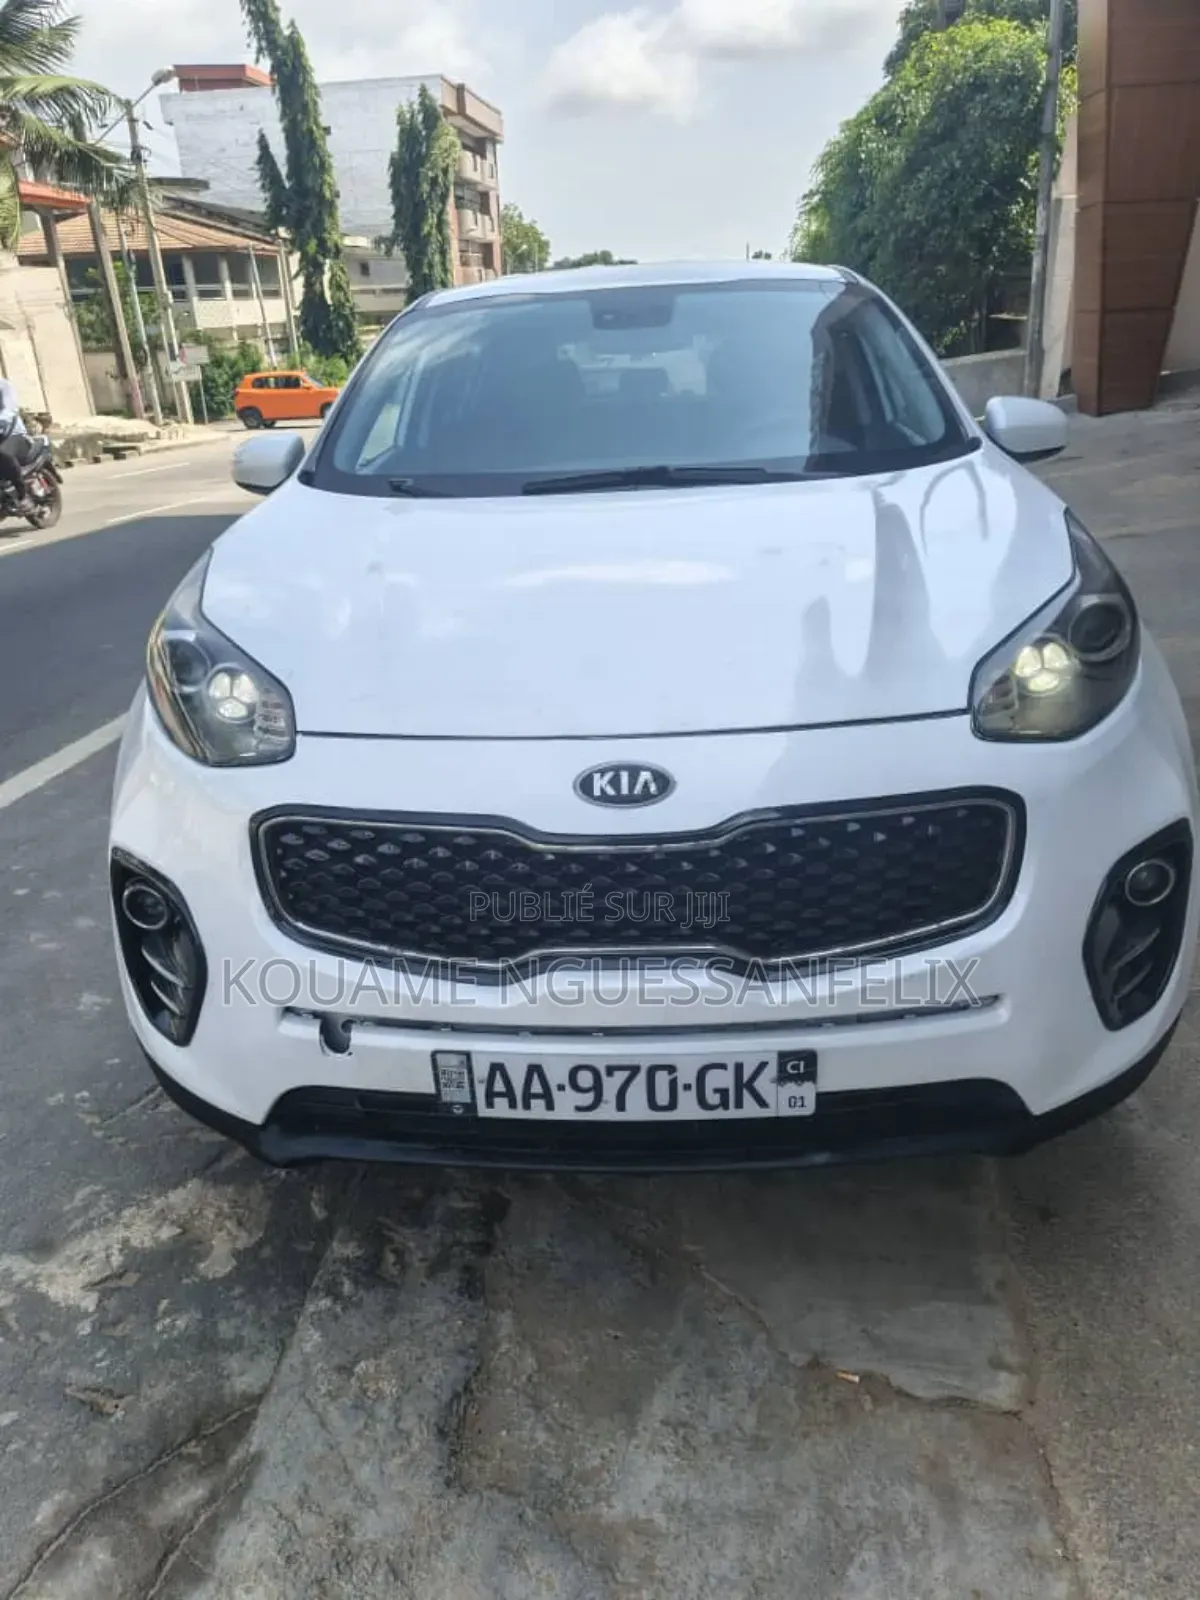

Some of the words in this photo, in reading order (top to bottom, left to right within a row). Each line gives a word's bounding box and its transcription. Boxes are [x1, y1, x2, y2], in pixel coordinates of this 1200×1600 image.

[593, 770, 659, 796] KIA
[786, 1060, 805, 1074] CI
[788, 1095, 807, 1109] 01
